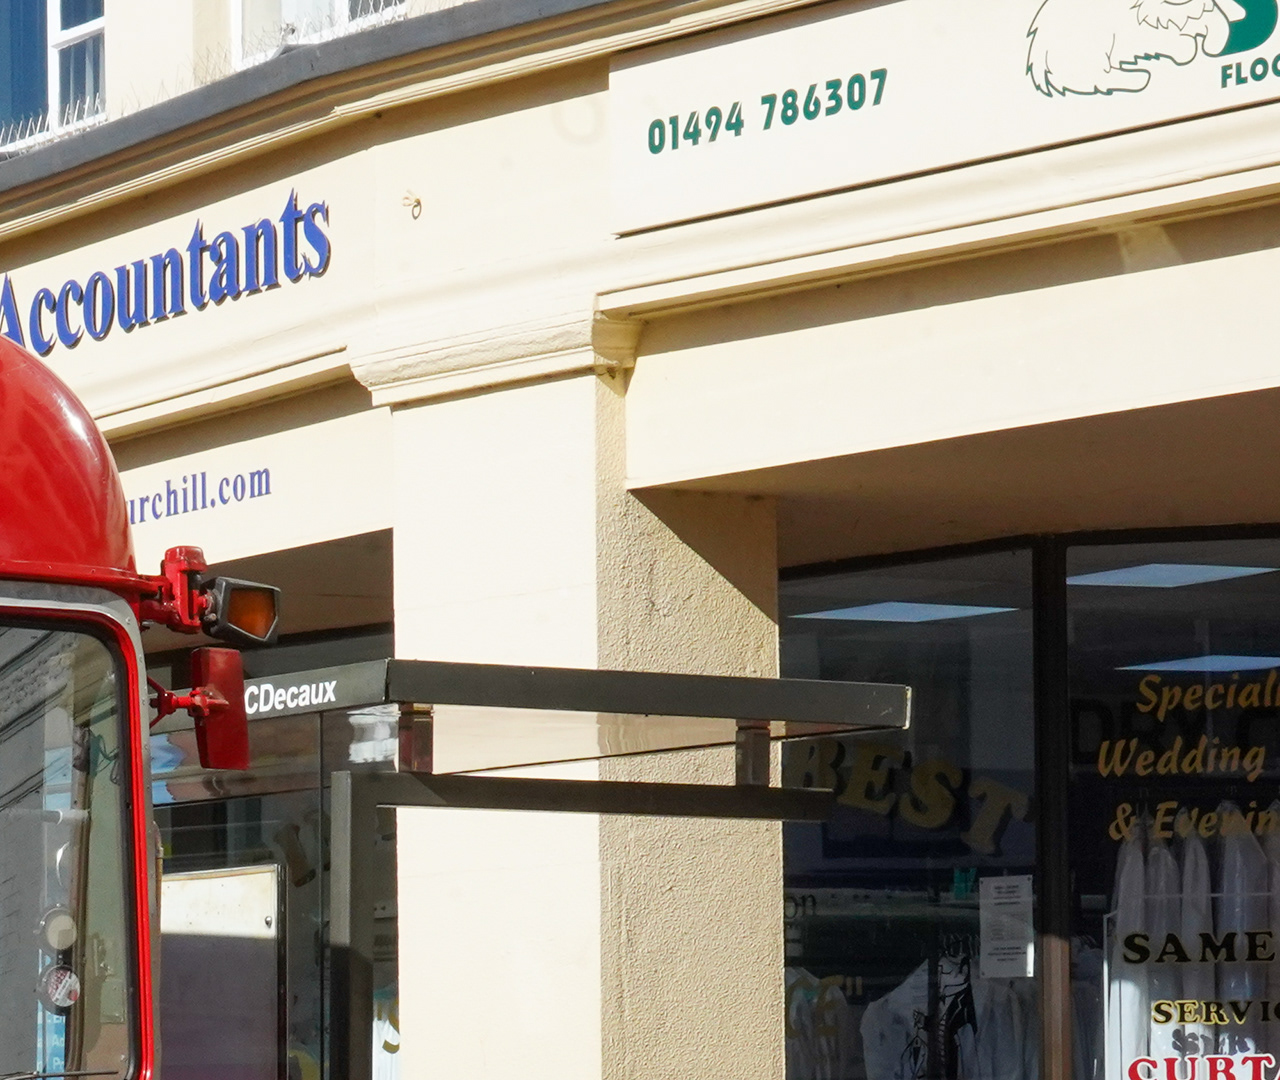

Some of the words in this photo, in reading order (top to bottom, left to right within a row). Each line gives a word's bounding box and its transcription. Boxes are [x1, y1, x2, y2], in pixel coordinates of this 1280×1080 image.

[647, 101, 745, 155] 01494
[760, 67, 888, 131] 786307
[1098, 733, 1267, 783] Wedding
[1108, 802, 1138, 841] &
[1122, 930, 1276, 965] SAME
